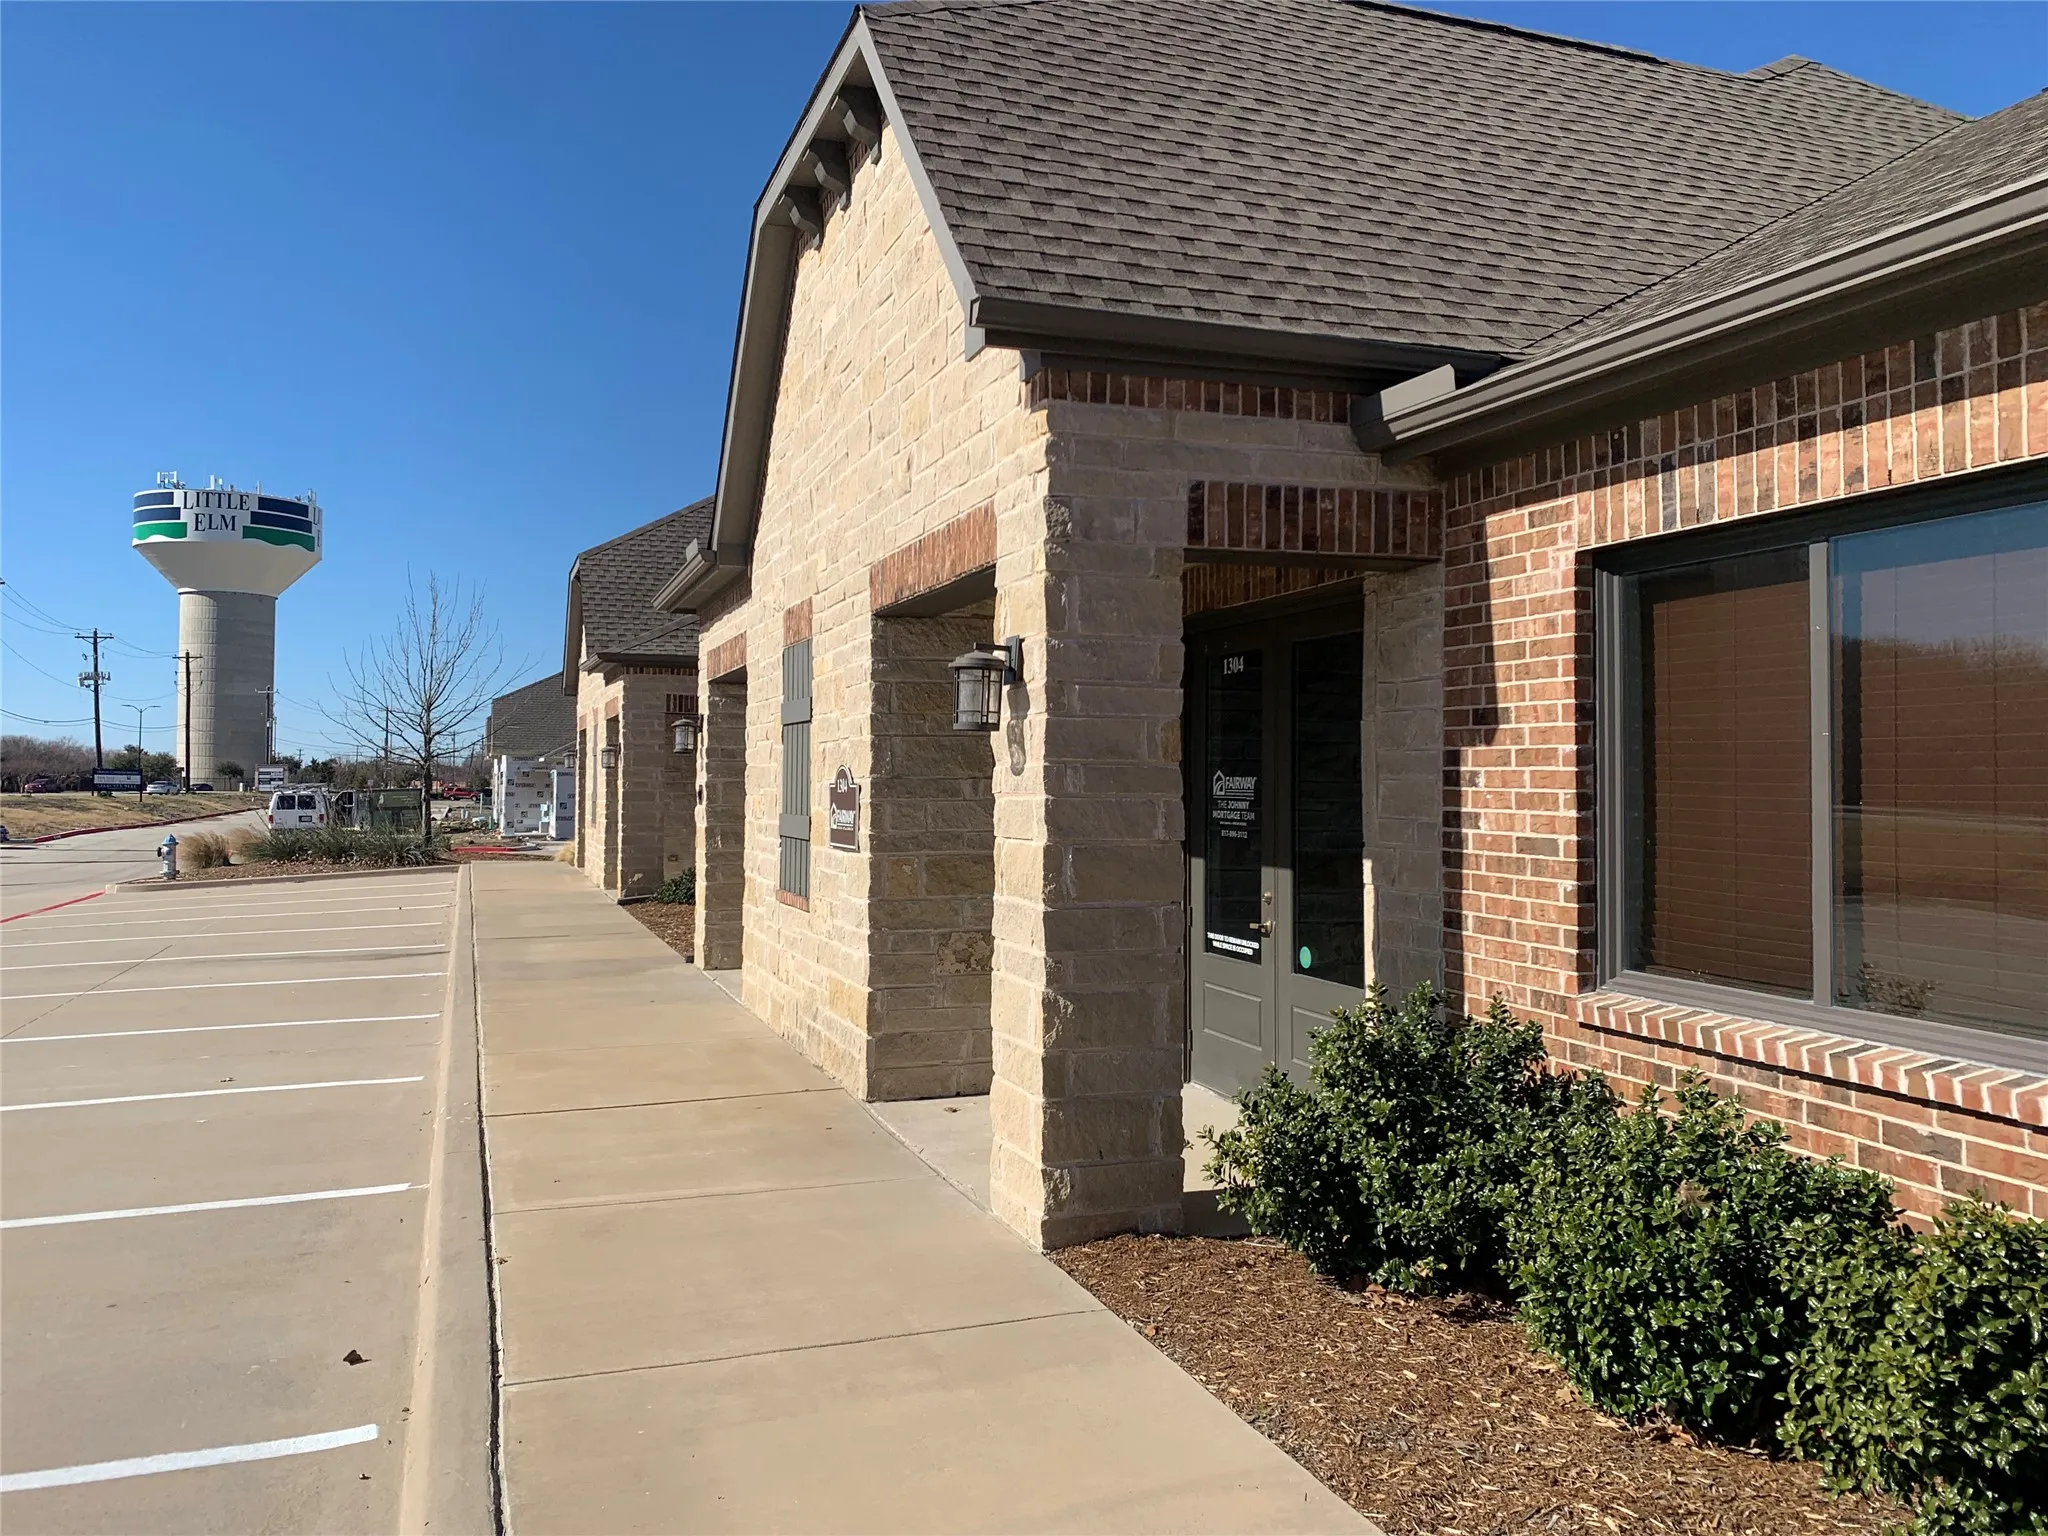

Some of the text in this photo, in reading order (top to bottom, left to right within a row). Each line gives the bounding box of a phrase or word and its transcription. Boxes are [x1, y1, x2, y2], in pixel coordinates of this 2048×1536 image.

[182, 491, 250, 511] LITTLE
[193, 513, 237, 532] ELM
[1223, 656, 1244, 675] 1304
[1225, 776, 1256, 790] FAIRWAY
[1217, 800, 1250, 810] THE JOHNNY
[837, 809, 856, 824] FAIRWAY
[1212, 810, 1255, 821] MORTGAGE TEAM
